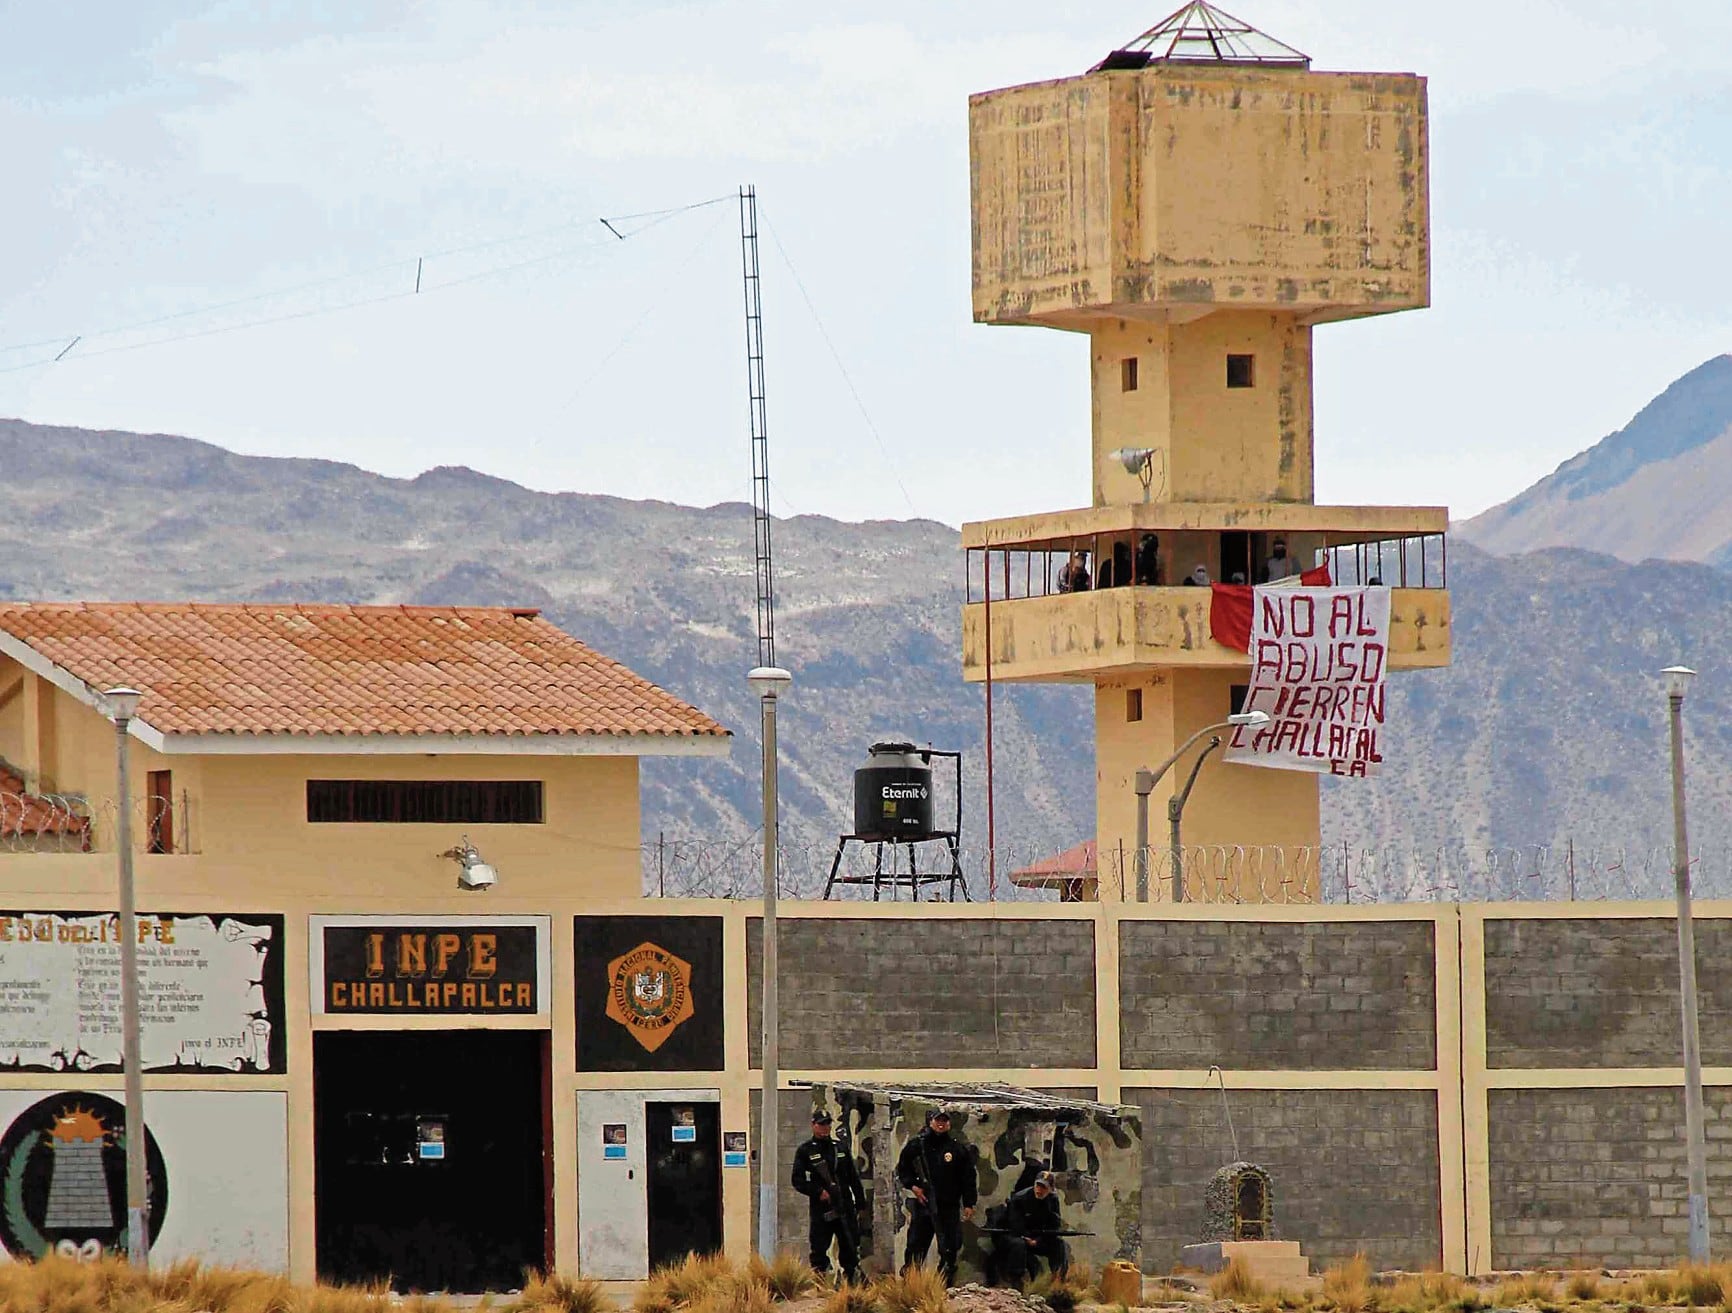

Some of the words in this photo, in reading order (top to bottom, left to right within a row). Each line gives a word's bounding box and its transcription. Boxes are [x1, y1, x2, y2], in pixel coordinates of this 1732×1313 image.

[1262, 594, 1315, 639] NO
[1328, 593, 1377, 639] AL
[1256, 638, 1384, 684] ABUSO
[881, 786, 920, 799] Eternit
[100, 918, 175, 945] IPE
[366, 933, 497, 979] INPE
[332, 981, 531, 1007] CHALLAPALCA
